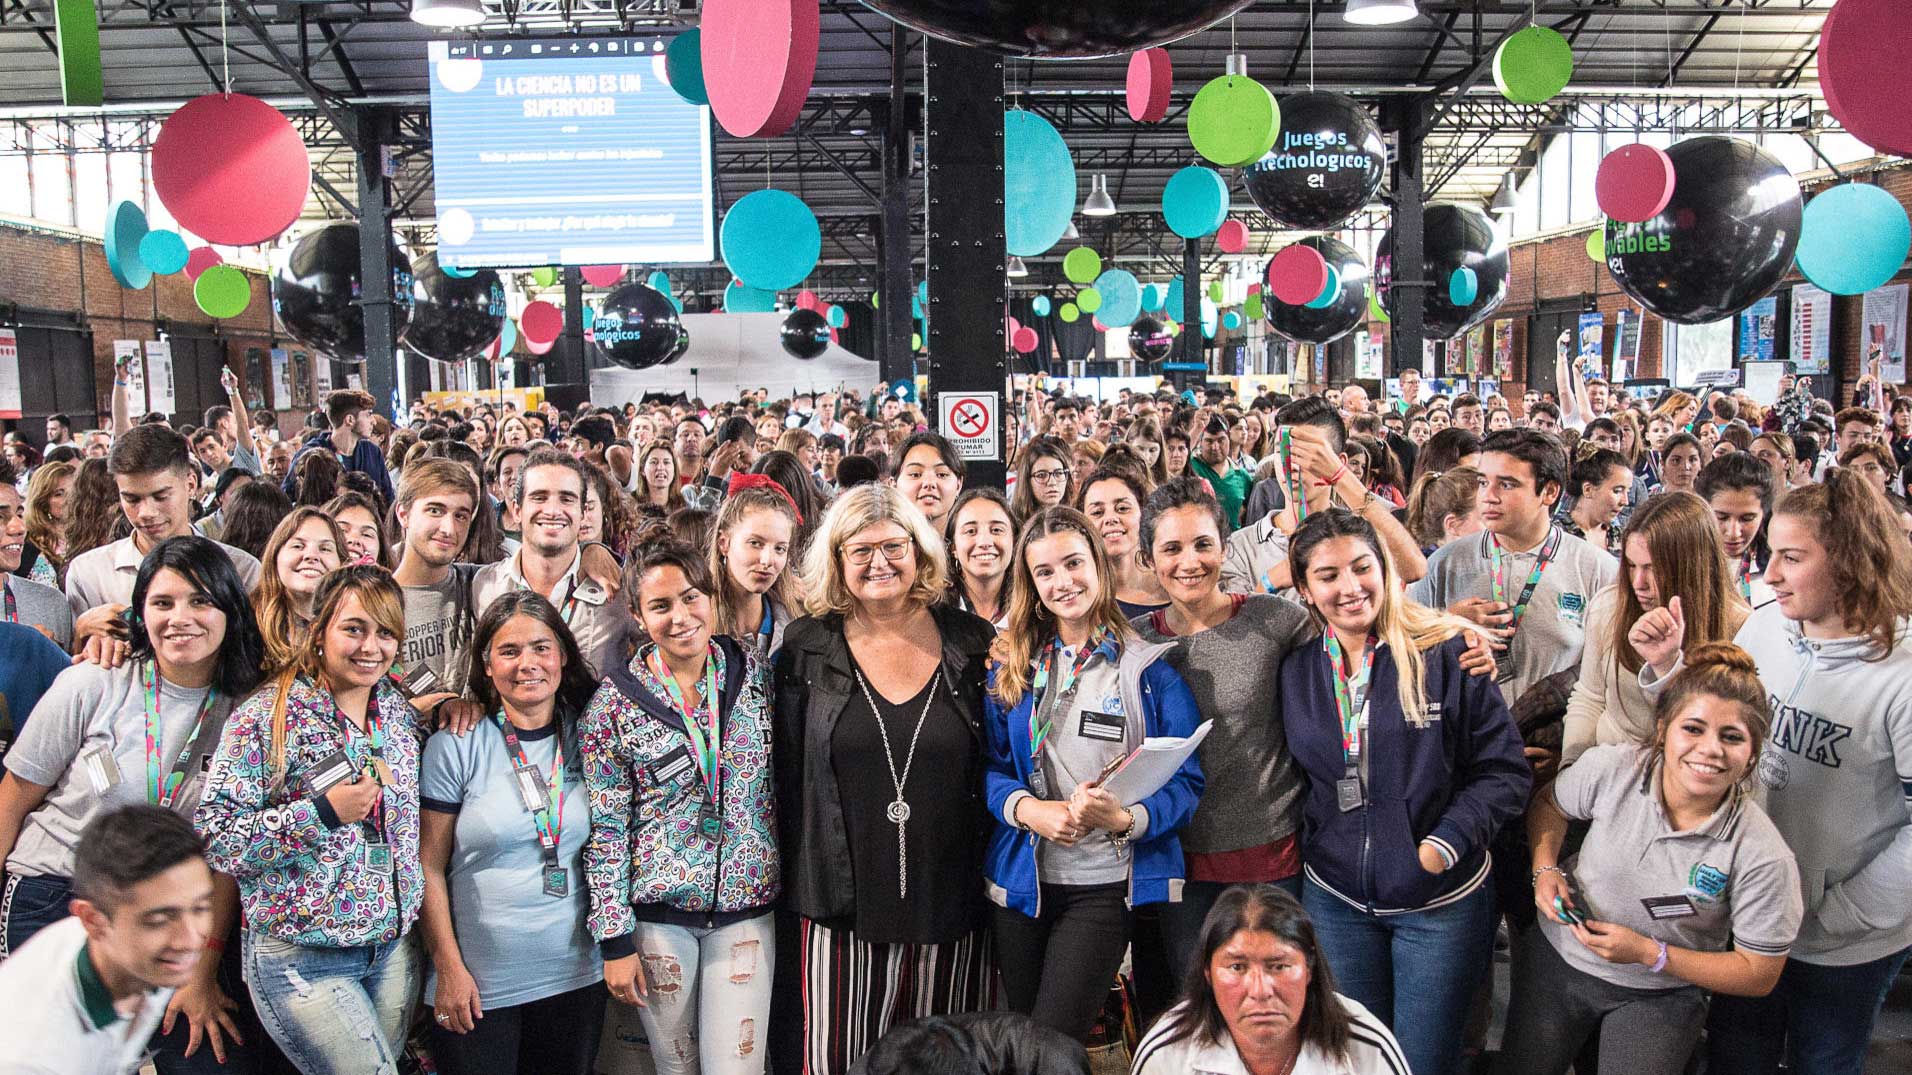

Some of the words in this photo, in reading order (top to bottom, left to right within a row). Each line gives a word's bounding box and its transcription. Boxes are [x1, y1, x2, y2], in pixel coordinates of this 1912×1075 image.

[496, 77, 514, 96] LA
[516, 75, 573, 95] CIENCIA
[575, 75, 597, 94] NO
[600, 74, 617, 93] ES
[620, 74, 641, 92] UN
[523, 97, 615, 117] SUPERPODER
